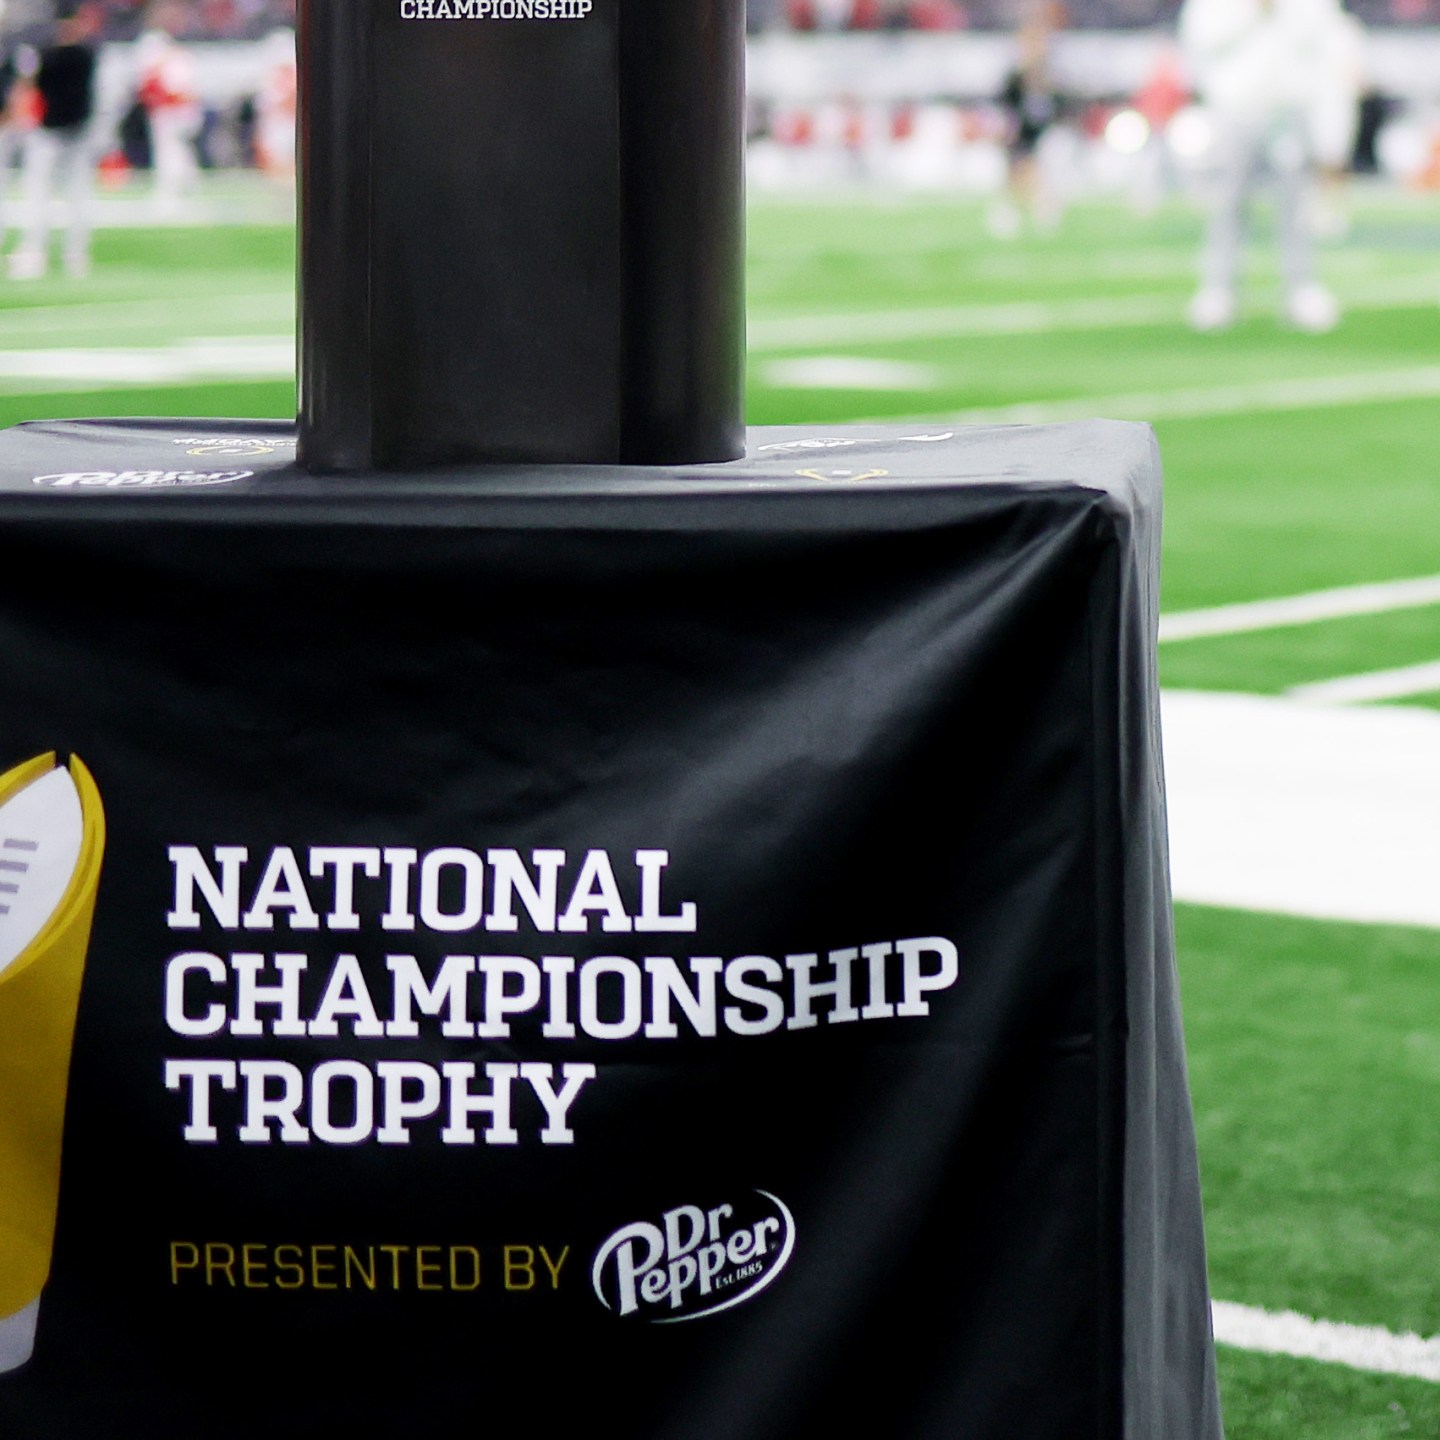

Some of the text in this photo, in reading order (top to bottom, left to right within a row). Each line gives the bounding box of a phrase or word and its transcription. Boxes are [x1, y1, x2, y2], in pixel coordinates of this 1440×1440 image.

[167, 846, 697, 933] NATIONAL
[165, 936, 959, 1040] CHAMPIONSHIP
[165, 1059, 597, 1145] TROPHY
[170, 1242, 570, 1291] PRESENTED BY
[592, 1216, 780, 1317] Pepper
[662, 1203, 733, 1261] Dr
